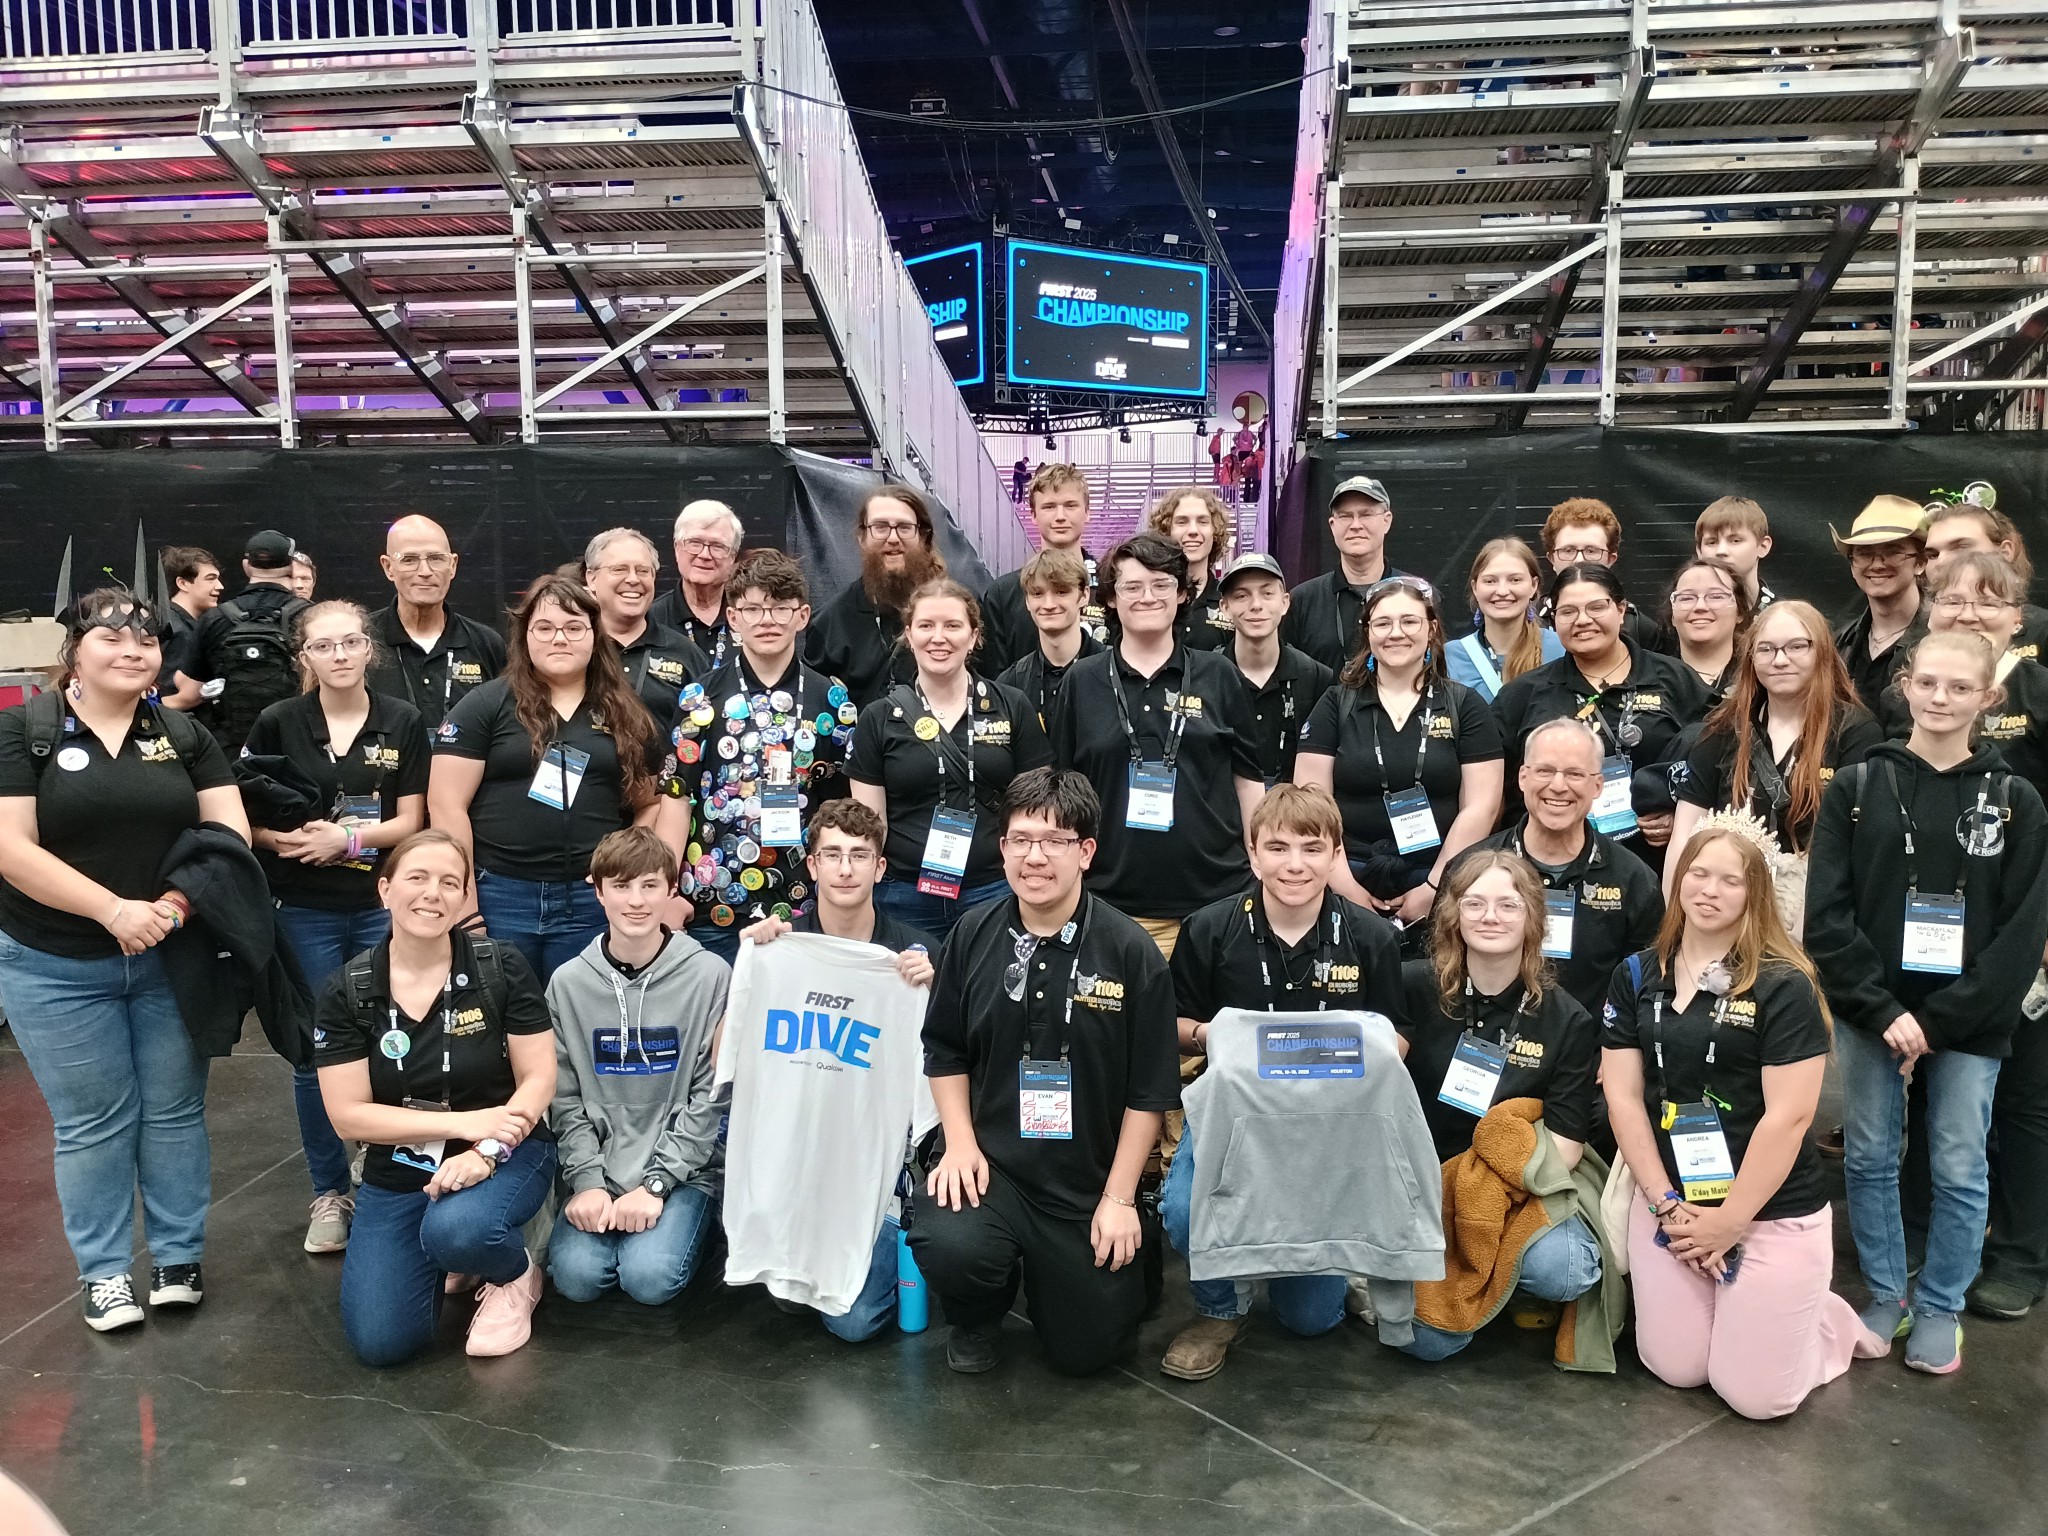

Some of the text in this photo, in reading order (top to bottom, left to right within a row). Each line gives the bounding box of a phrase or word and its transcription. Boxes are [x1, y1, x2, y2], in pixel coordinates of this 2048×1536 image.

[1038, 282, 1097, 301] FIRST 2025
[1034, 297, 1190, 334] CHAMPIONSHIP
[1095, 361, 1127, 378] DIVE
[461, 663, 481, 675] 1108
[986, 720, 1011, 734] 1108
[2000, 714, 2027, 729] 1108
[927, 871, 943, 879] FIRST
[1596, 886, 1621, 900] 1108
[1330, 965, 1359, 980] 1108
[1094, 980, 1124, 999] 1108
[805, 991, 854, 1010] FIRST
[1074, 994, 1122, 1007] PANTHER ROBOTICS
[456, 1007, 484, 1025] 1108
[1729, 1000, 1756, 1017] 1108
[763, 1009, 881, 1069] DIVE
[1267, 1037, 1358, 1052] CHAMPIONSHIP
[1515, 1039, 1544, 1057] 1108
[1463, 1065, 1486, 1078] GEORGIA
[1691, 1188, 1710, 1197] G'day
